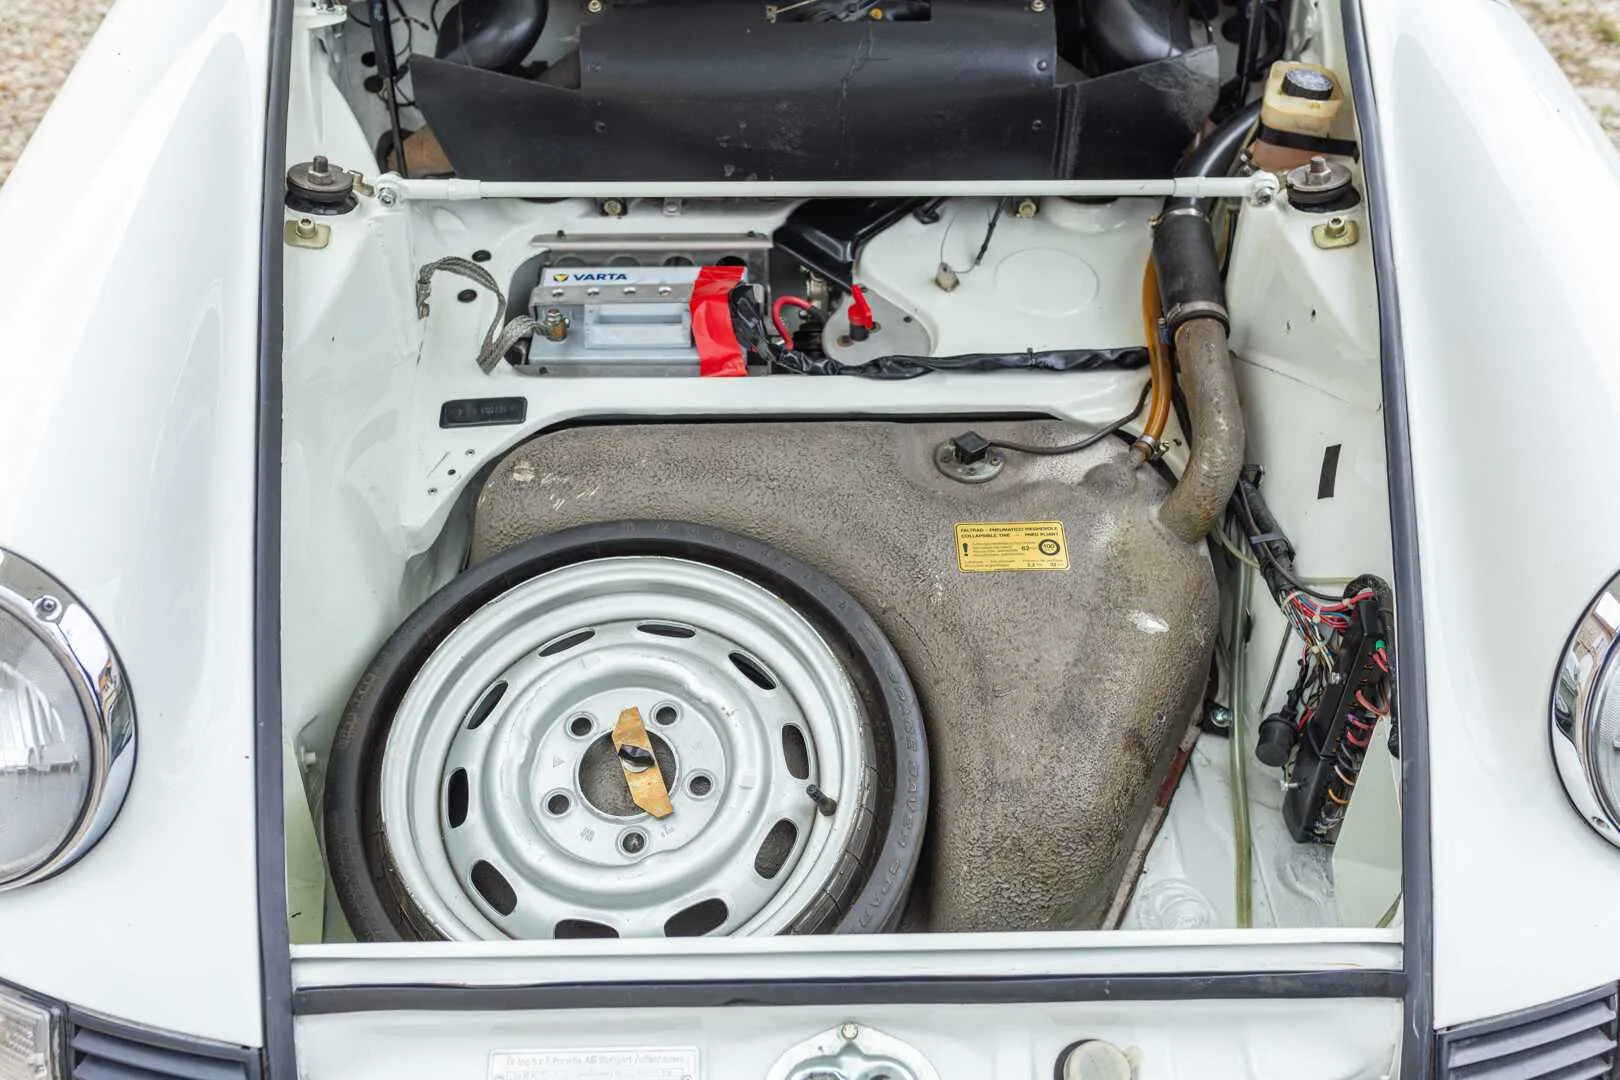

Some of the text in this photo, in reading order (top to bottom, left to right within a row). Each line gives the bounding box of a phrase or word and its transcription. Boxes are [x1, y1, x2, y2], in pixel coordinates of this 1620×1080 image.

[572, 273, 628, 281] VARTA
[887, 668, 919, 752] SPACE
[896, 759, 921, 849] SAVER
